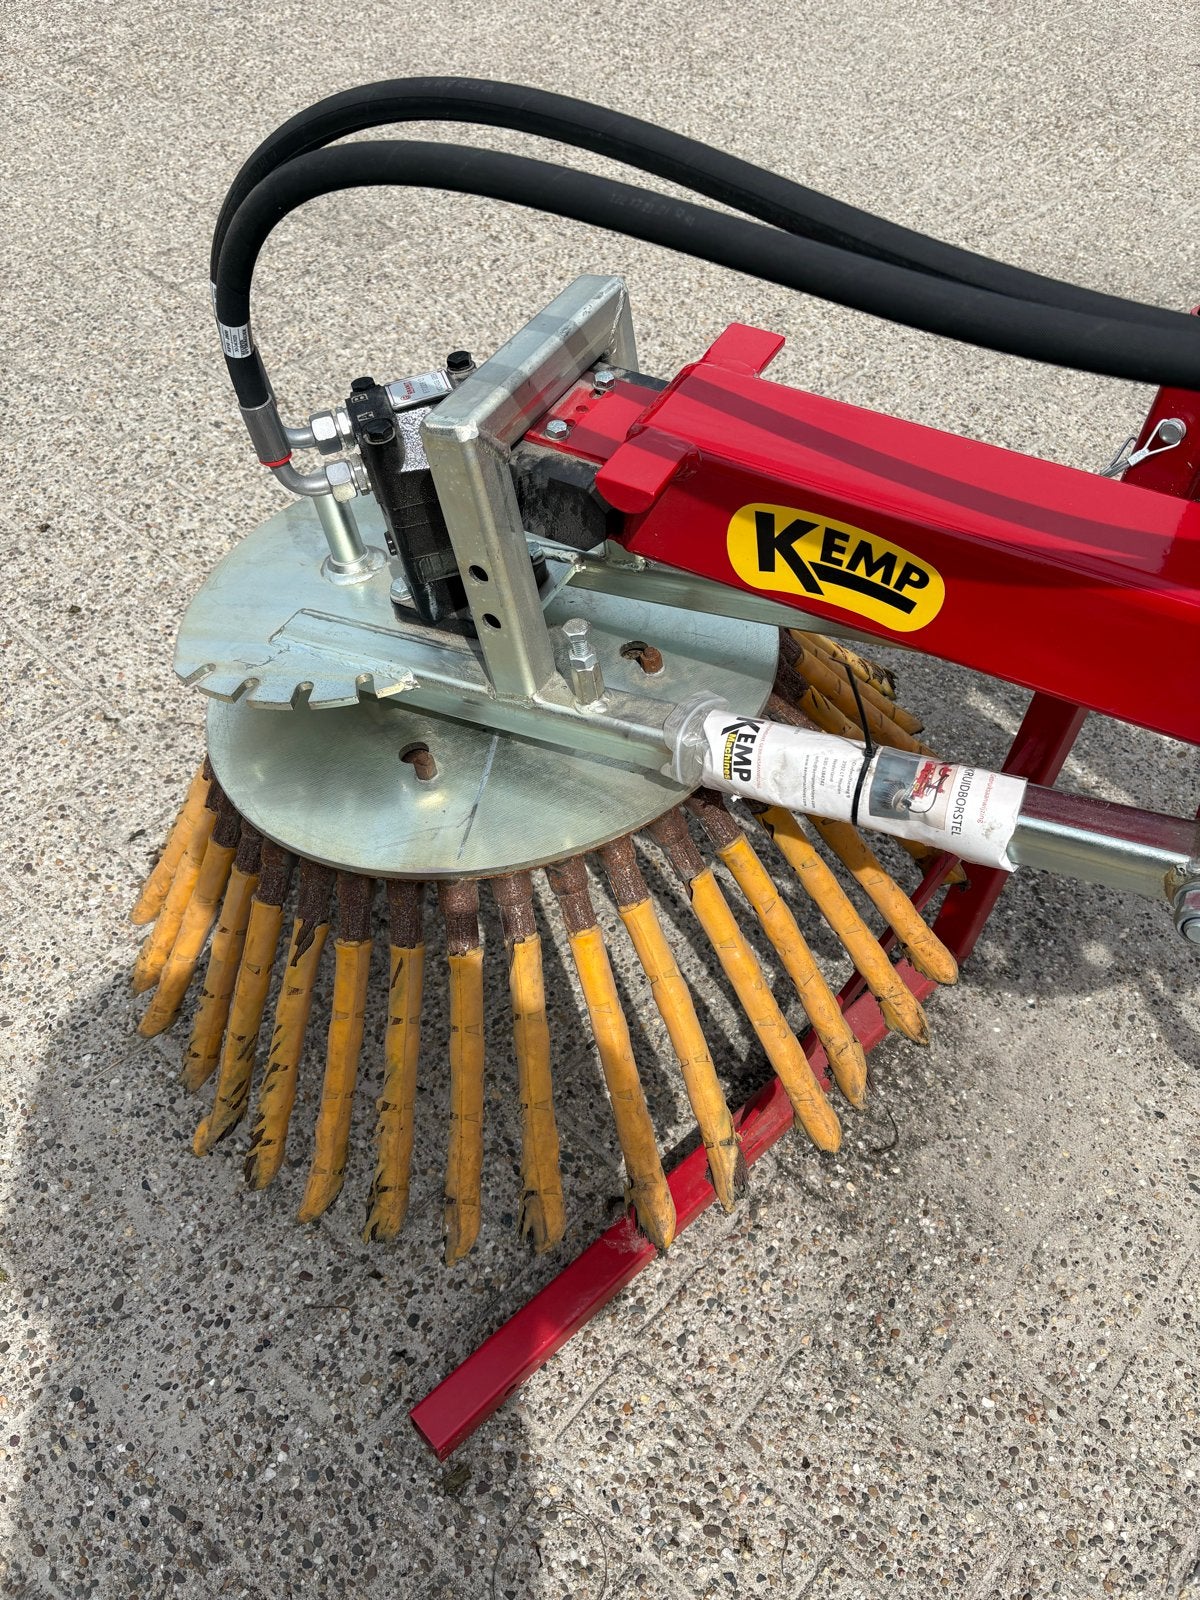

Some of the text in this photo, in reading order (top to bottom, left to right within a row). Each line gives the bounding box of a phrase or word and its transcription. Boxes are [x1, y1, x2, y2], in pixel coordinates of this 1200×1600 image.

[755, 510, 930, 596] KEMP
[721, 717, 765, 781] KEMP
[723, 732, 737, 780] Machines
[951, 768, 976, 836] KRUIDBORSTEL
[977, 773, 997, 824] Gebruiksaanwijzing
